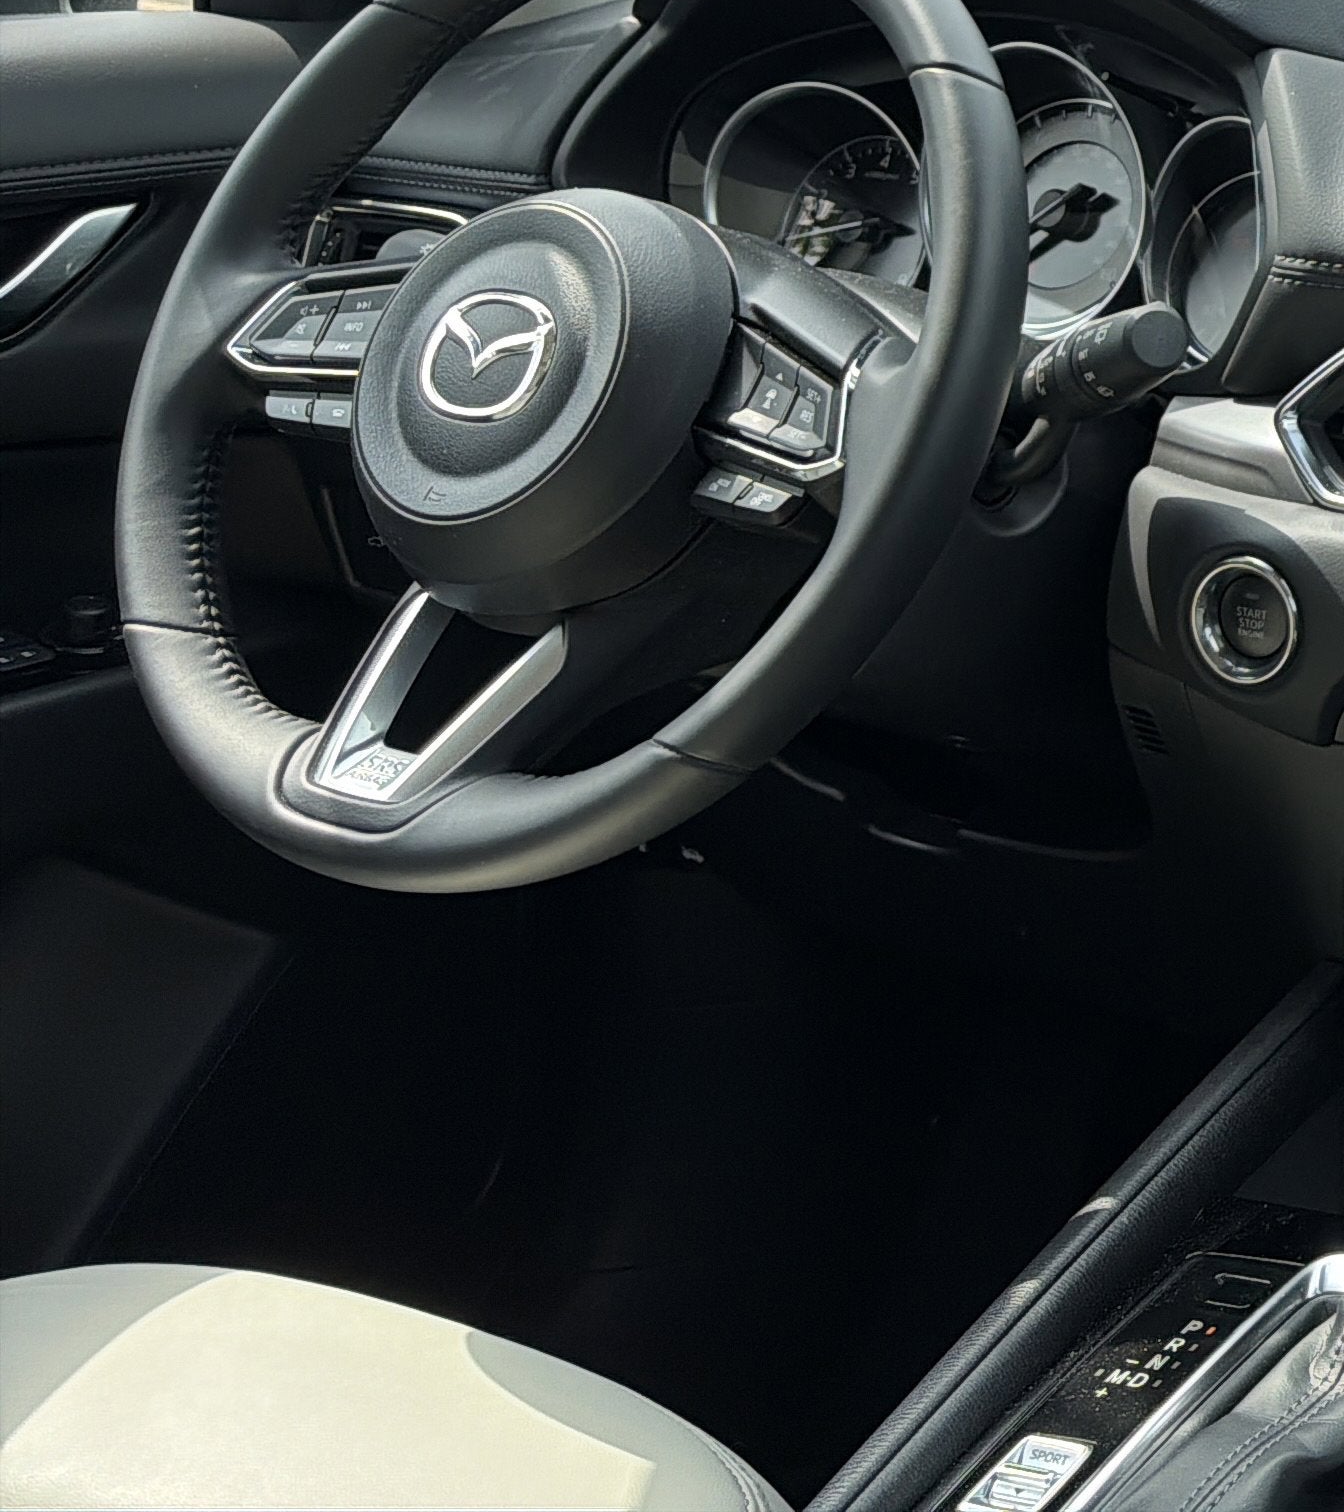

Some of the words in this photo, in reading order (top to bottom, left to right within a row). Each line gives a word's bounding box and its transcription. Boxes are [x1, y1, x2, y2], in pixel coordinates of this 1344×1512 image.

[1236, 606, 1267, 620] START
[1238, 618, 1265, 630] STOP
[1180, 1319, 1204, 1335] P
[1163, 1337, 1186, 1352] R
[1143, 1353, 1171, 1371] N
[1028, 1448, 1071, 1466] SPORT
